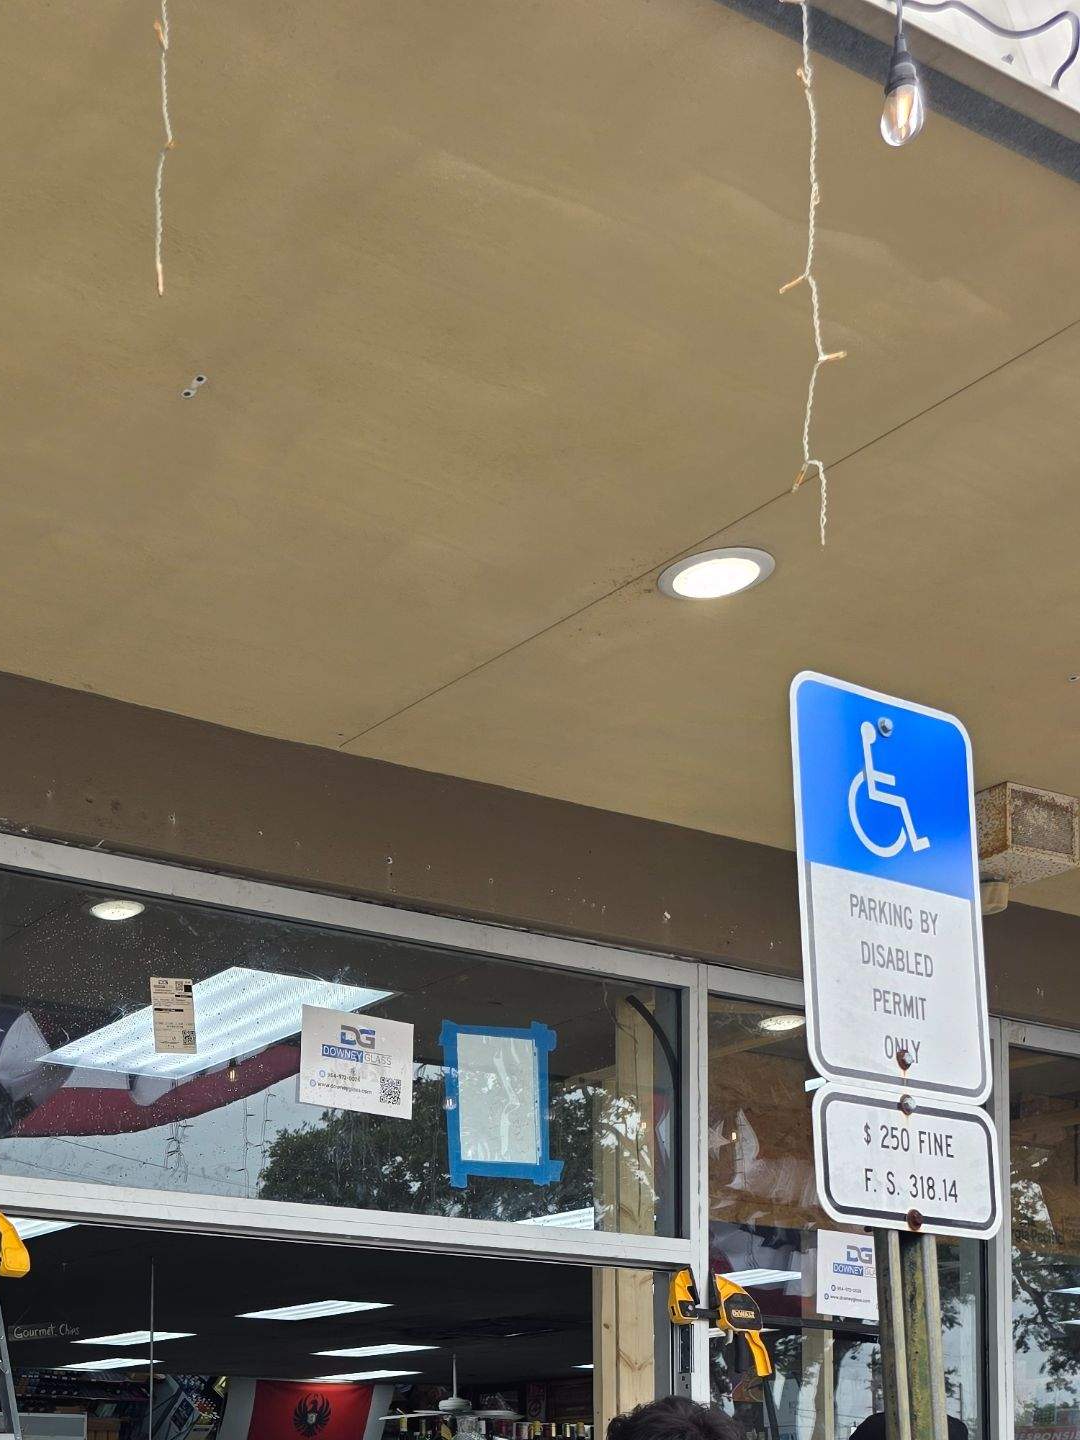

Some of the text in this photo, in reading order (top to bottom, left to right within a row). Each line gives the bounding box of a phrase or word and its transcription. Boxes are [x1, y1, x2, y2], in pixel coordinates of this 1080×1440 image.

[849, 893, 938, 937] PARKING BY
[860, 940, 934, 979] DISABLED
[872, 987, 927, 1021] PERMIT
[322, 1045, 392, 1066] DOWNEY GLASS
[863, 1122, 955, 1159] $ 250 FINE
[864, 1168, 958, 1204] F. S. 318.14
[833, 1263, 864, 1276] DOWNEY
[13, 1323, 55, 1339] Gourmet
